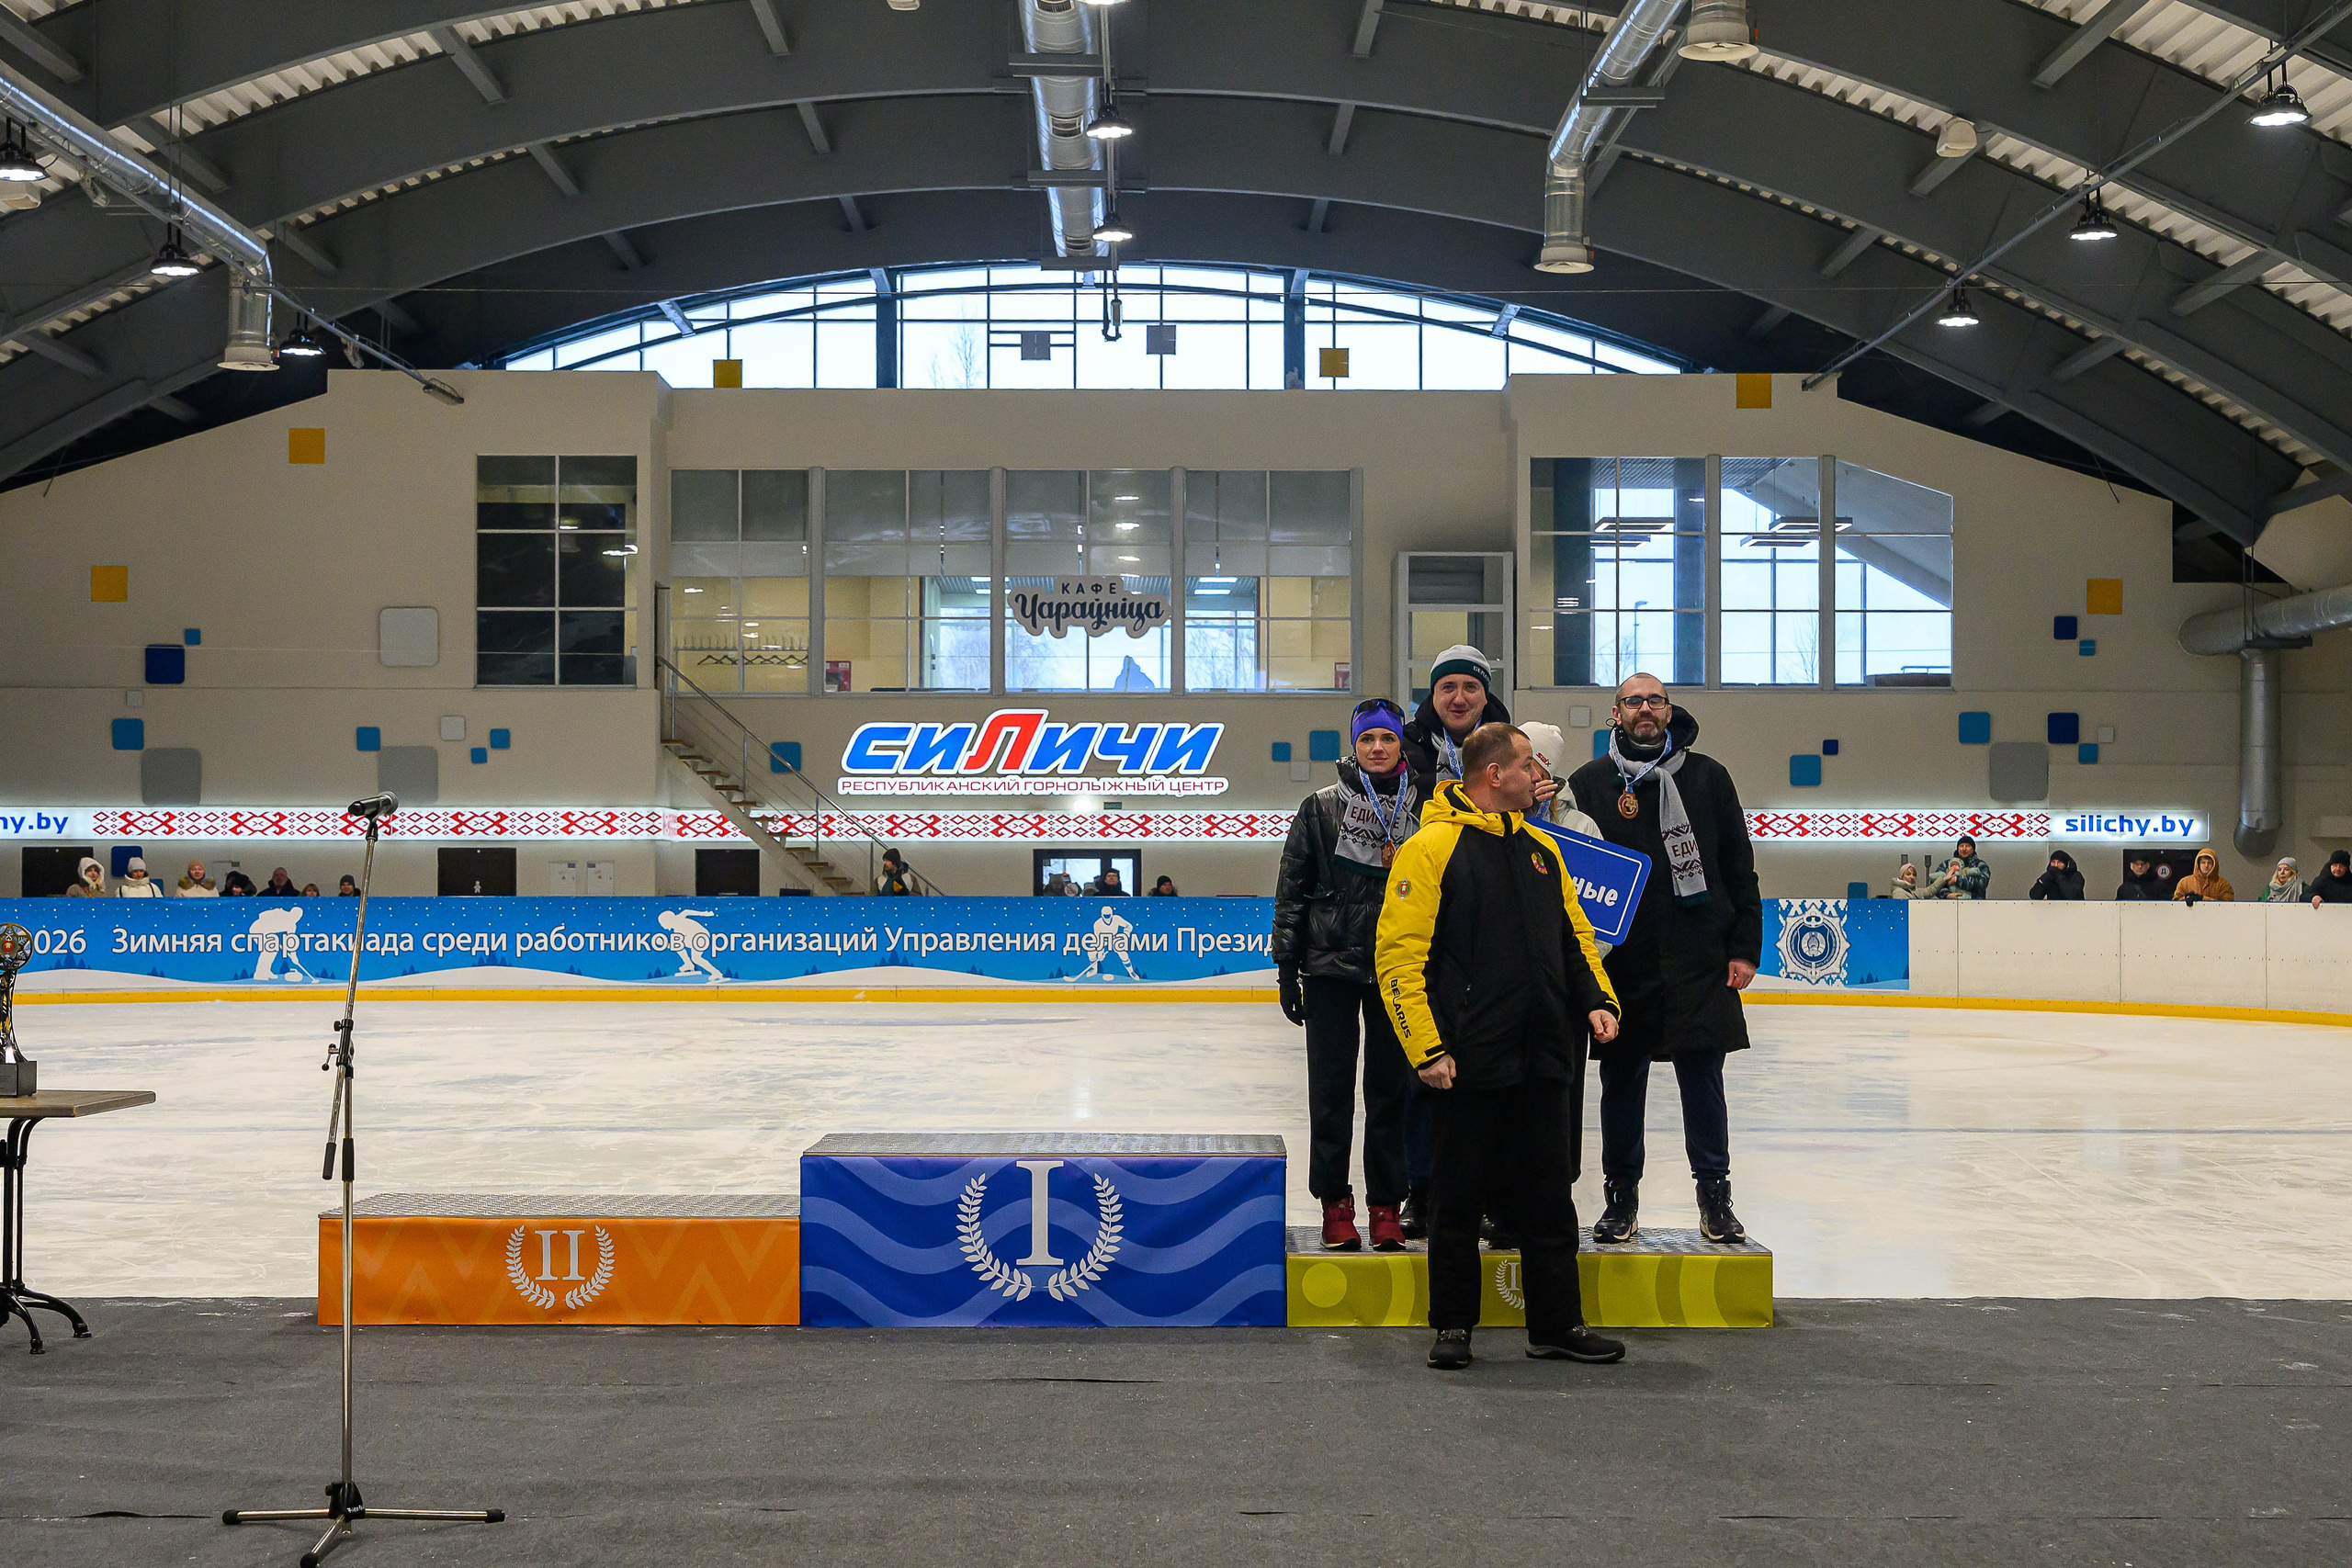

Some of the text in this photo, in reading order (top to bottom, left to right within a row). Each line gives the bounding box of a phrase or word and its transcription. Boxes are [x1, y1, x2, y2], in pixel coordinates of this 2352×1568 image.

[1061, 582, 1117, 594] КАФЕ
[1014, 593, 1164, 631] Чараўніца
[842, 779, 1225, 794] РЕСПУБЛИКАНСКИЙ ГОРНОЛЫЖНЫЙ ЦЕНТР
[2065, 815, 2195, 837] silichy.by
[33, 929, 86, 954] 026
[111, 928, 222, 953] Зимняя
[422, 931, 507, 957] среди
[515, 924, 685, 957] работников
[691, 926, 877, 957] организаций
[884, 926, 1056, 957] Управления
[1062, 931, 1168, 956] делами
[1390, 978, 1412, 1039] BELARUS
